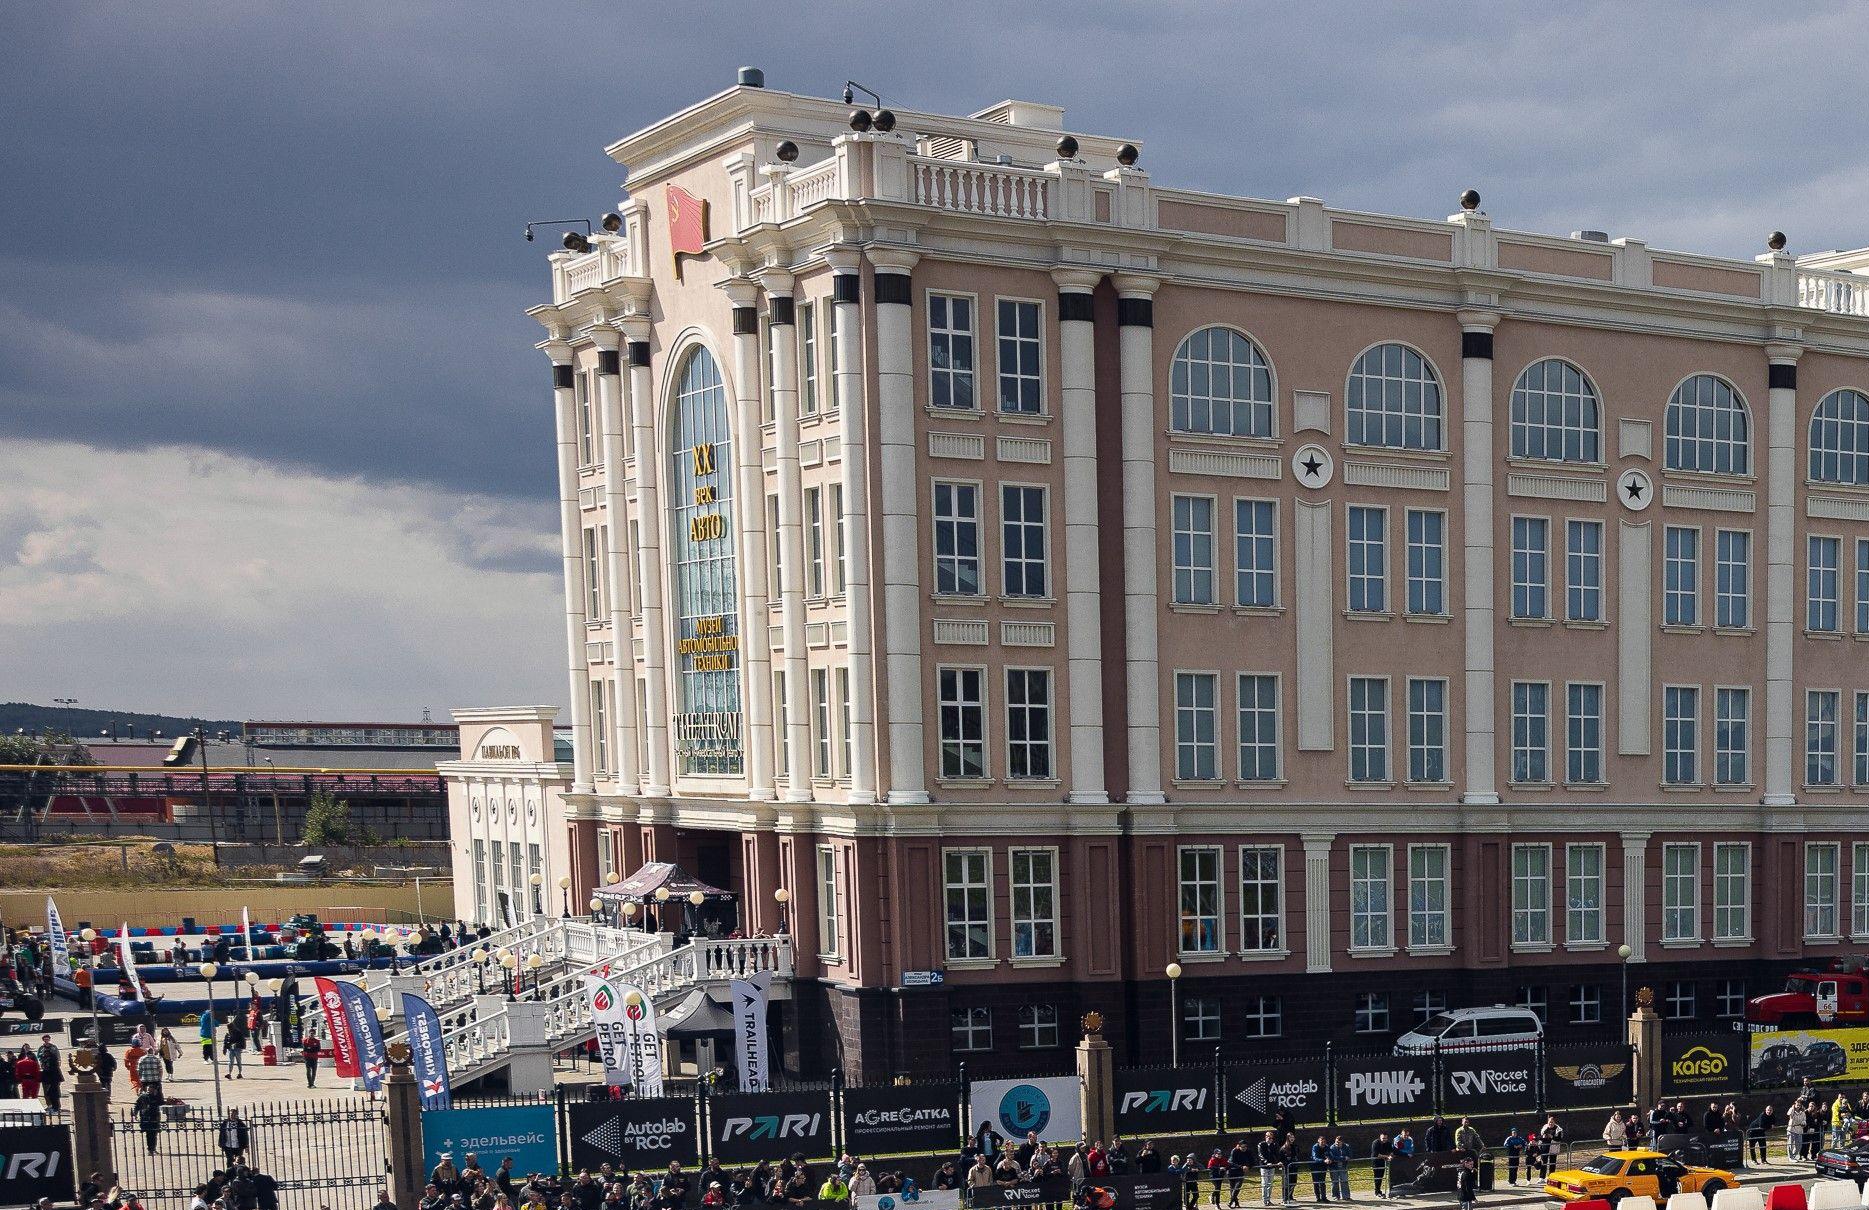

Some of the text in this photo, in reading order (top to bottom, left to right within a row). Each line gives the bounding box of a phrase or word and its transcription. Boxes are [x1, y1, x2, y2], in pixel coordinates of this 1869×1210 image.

[691, 514, 723, 542] АВТО
[696, 616, 722, 635] МУЗЕЙ
[693, 655, 728, 672] ТЕХНИКИ
[9, 1022, 44, 1033] PARI
[612, 1021, 628, 1047] GET
[597, 1023, 618, 1074] PETROL
[643, 1033, 658, 1060] GET
[744, 1012, 760, 1088] TRAILHEAD
[1486, 1068, 1528, 1082] Rocket
[1269, 1079, 1318, 1096] Autolab
[1493, 1078, 1527, 1093] Voice
[1120, 1087, 1207, 1115] PARI
[1278, 1095, 1307, 1108] RCC
[854, 1107, 951, 1126] AGREGATKA
[624, 1117, 686, 1136] Autolab
[721, 1112, 821, 1142] PARI
[854, 1126, 914, 1135] ПРОФЕССИОНАЛЬНЫЙ
[460, 1132, 545, 1149] эдельвейс
[624, 1136, 634, 1145] BY
[635, 1134, 672, 1151] RCC
